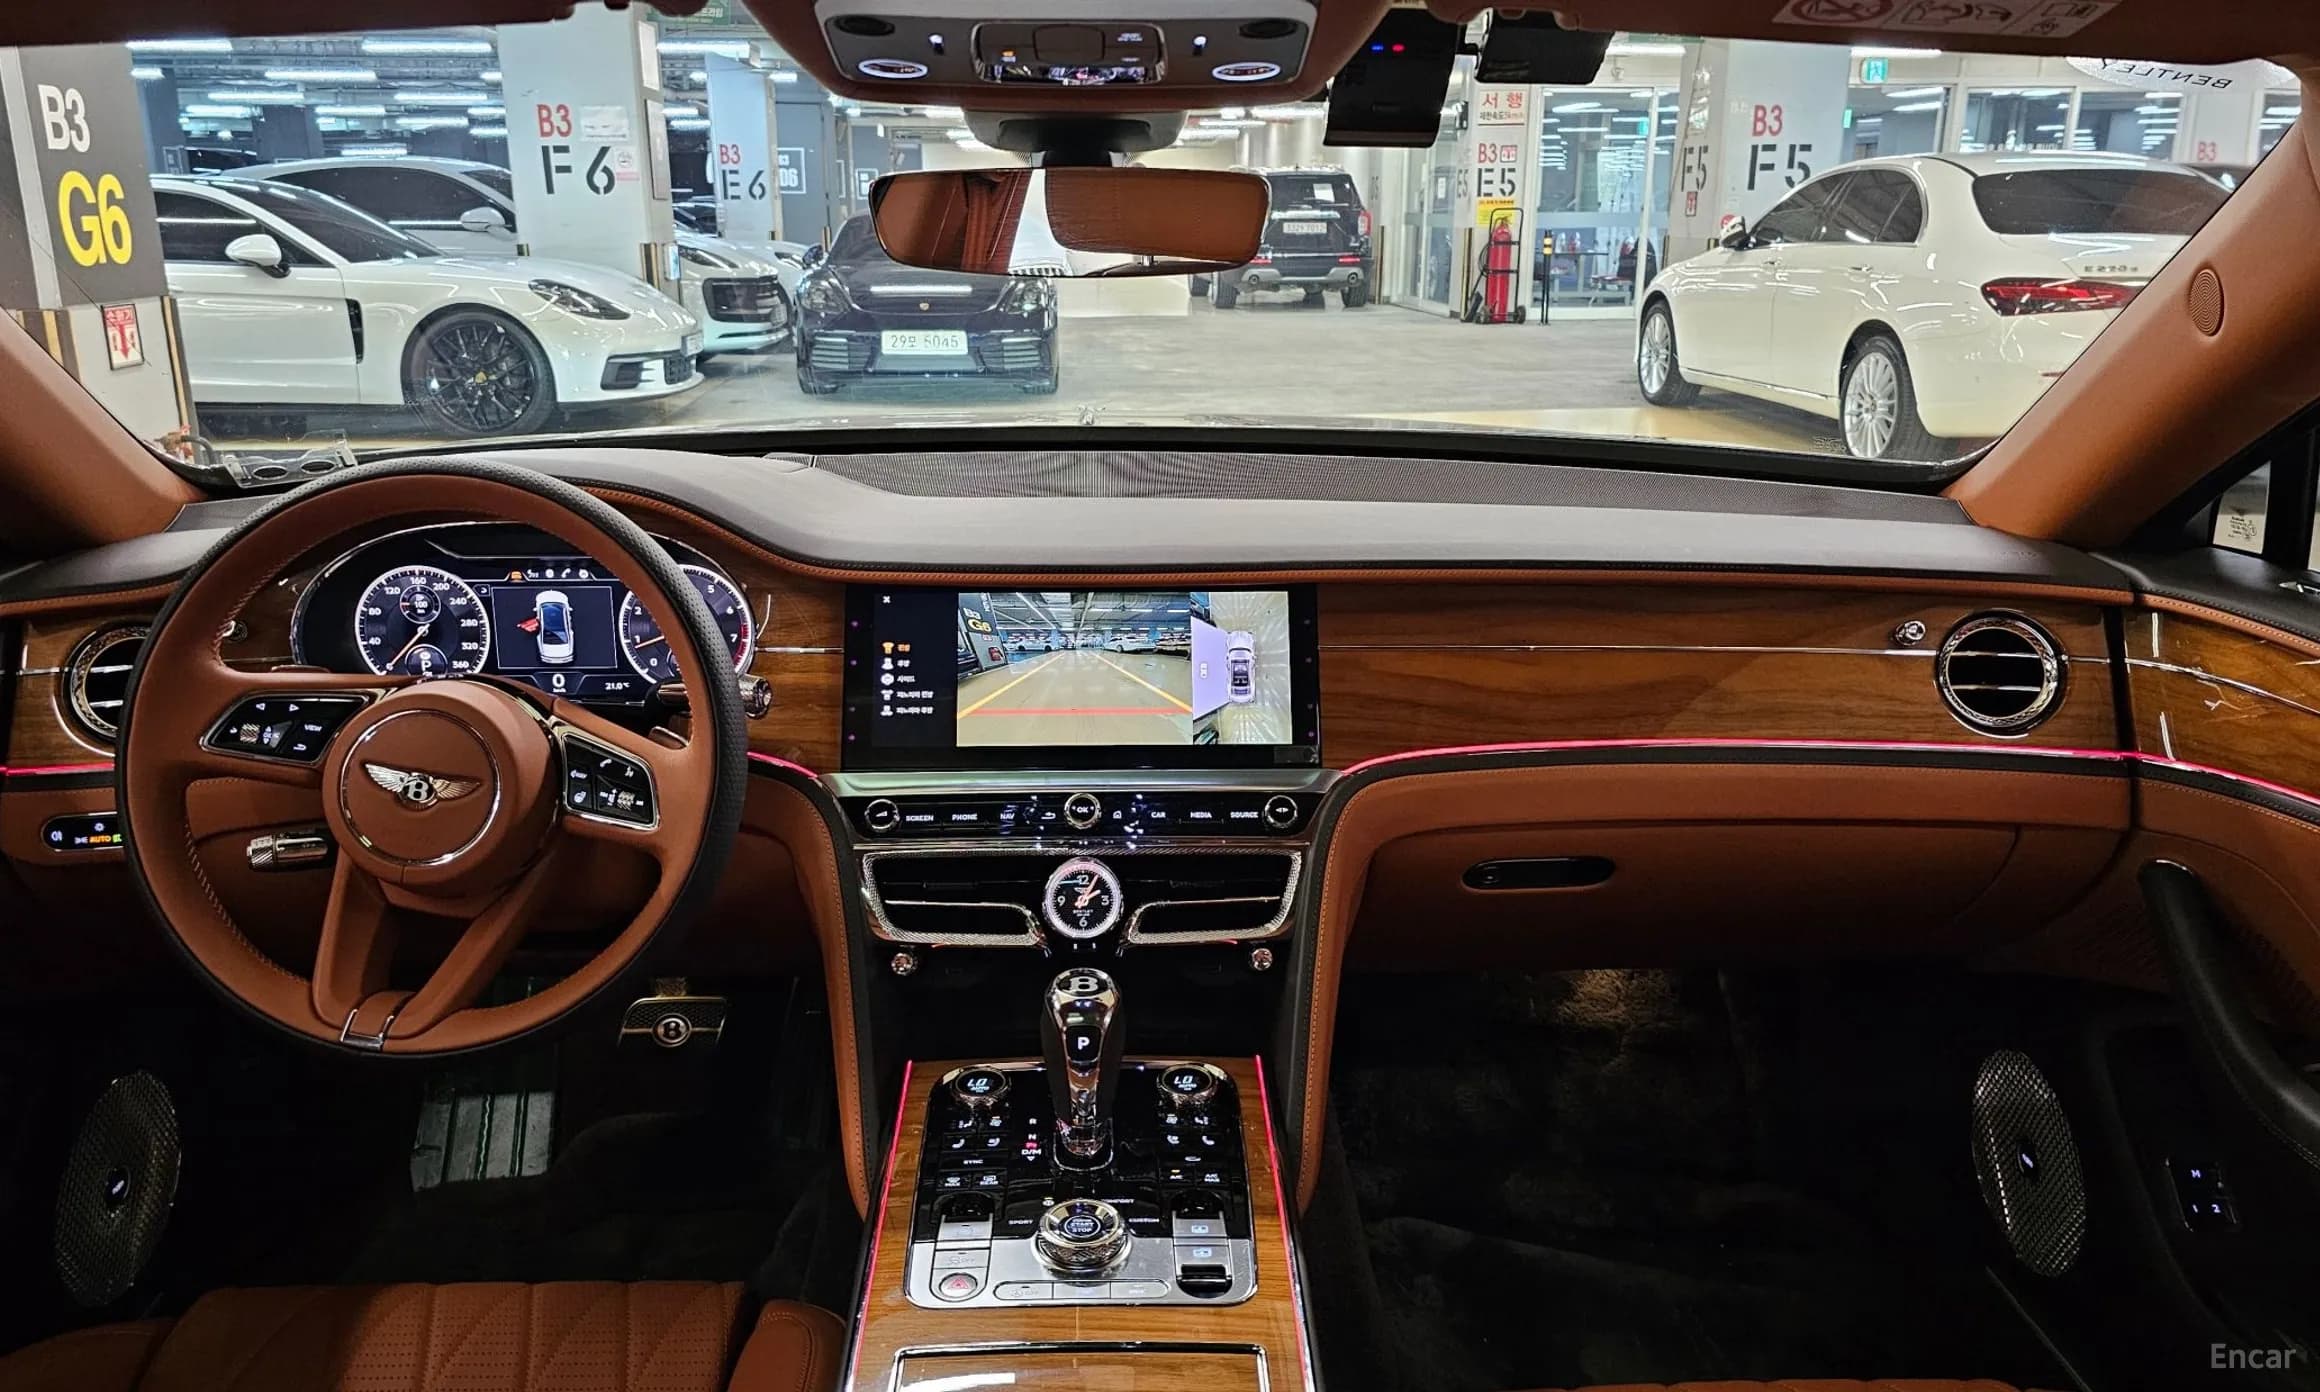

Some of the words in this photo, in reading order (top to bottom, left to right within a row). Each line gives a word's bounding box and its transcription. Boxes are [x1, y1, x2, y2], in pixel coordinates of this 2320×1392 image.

[38, 84, 91, 153] B3
[537, 104, 572, 137] B3
[1752, 104, 1783, 136] B3
[719, 144, 741, 164] B3
[1478, 143, 1498, 163] B3
[2197, 142, 2217, 161] B3
[1681, 145, 1709, 192] F5
[1747, 144, 1813, 191] F5
[722, 169, 767, 200] E6
[1477, 168, 1516, 197] E5
[58, 170, 132, 267] G6
[410, 577, 426, 585] 160
[385, 587, 400, 595] 120
[433, 583, 449, 591] 200
[708, 585, 714, 593] 5
[634, 606, 642, 615] 2
[726, 606, 734, 614] 6
[461, 619, 477, 627] 280
[369, 637, 381, 645] 40
[635, 635, 641, 643] 1
[730, 634, 737, 642] 7
[462, 642, 478, 650] 320
[452, 660, 469, 669] 360
[650, 658, 658, 666] 0
[552, 674, 565, 688] 0
[407, 780, 429, 800] B
[89, 834, 112, 843] AUTO
[1076, 874, 1090, 885] 12
[1057, 895, 1066, 907] 9
[1101, 895, 1110, 906] 3
[1078, 916, 1088, 927] 6
[1070, 976, 1098, 993] B
[1078, 1036, 1090, 1050] P
[2190, 1169, 2201, 1178] M
[2211, 1203, 2221, 1213] 2
